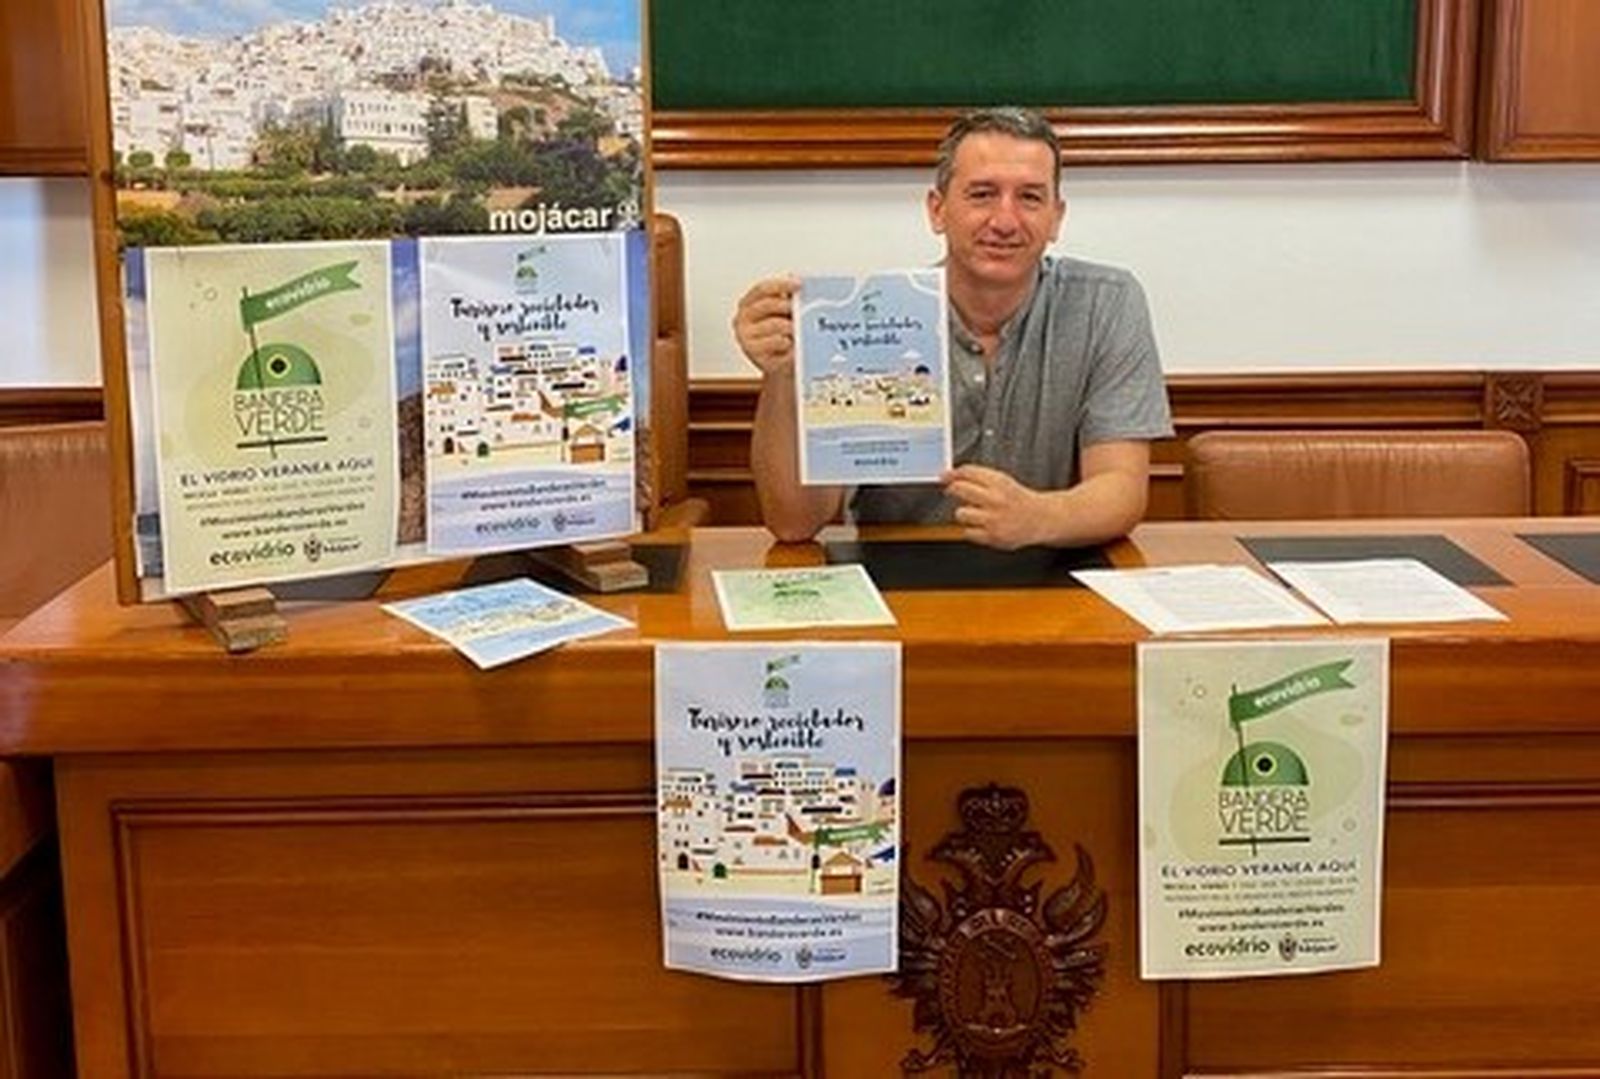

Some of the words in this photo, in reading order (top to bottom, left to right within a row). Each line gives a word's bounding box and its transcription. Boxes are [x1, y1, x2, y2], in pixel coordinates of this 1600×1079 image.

[489, 203, 612, 235] mojácar
[265, 276, 331, 308] ecovidrio
[477, 323, 490, 341] y
[234, 389, 324, 411] BANDERA
[235, 405, 325, 436] VERDE
[181, 475, 198, 486] EL
[203, 468, 257, 484] VIDRIO
[262, 461, 331, 479] VERANEA
[209, 541, 296, 566] ecovidrio
[1253, 676, 1321, 707] ecovidrio
[717, 737, 732, 756] y
[1219, 789, 1308, 811] BANDERA
[1219, 808, 1309, 833] VERDE
[1161, 865, 1178, 878] EL
[1183, 865, 1236, 878] VIDRIO
[1241, 862, 1312, 876] VERANEA
[1184, 936, 1271, 957] ecovidrio
